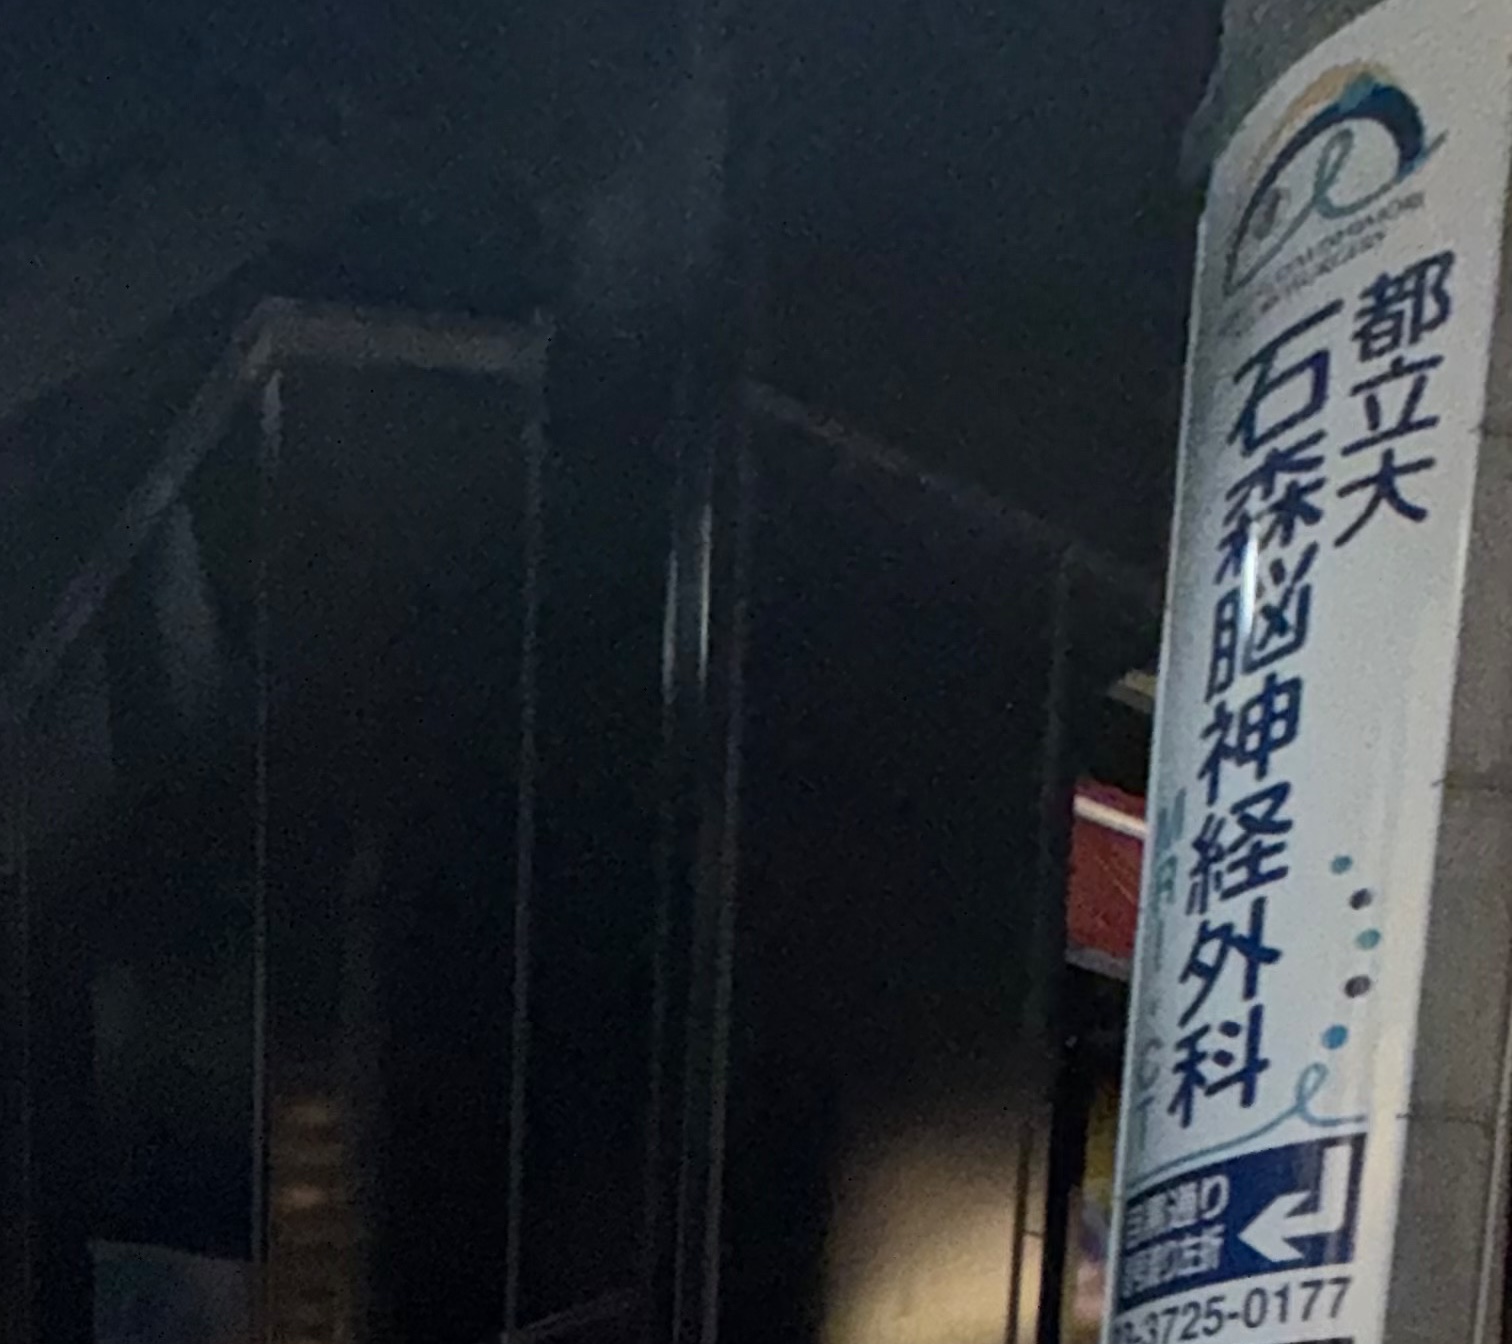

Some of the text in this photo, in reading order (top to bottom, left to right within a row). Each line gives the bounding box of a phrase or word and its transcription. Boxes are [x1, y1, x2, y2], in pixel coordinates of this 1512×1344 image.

[1334, 249, 1456, 548] 都立大
[1167, 298, 1344, 1129] 石森脳神経外科
